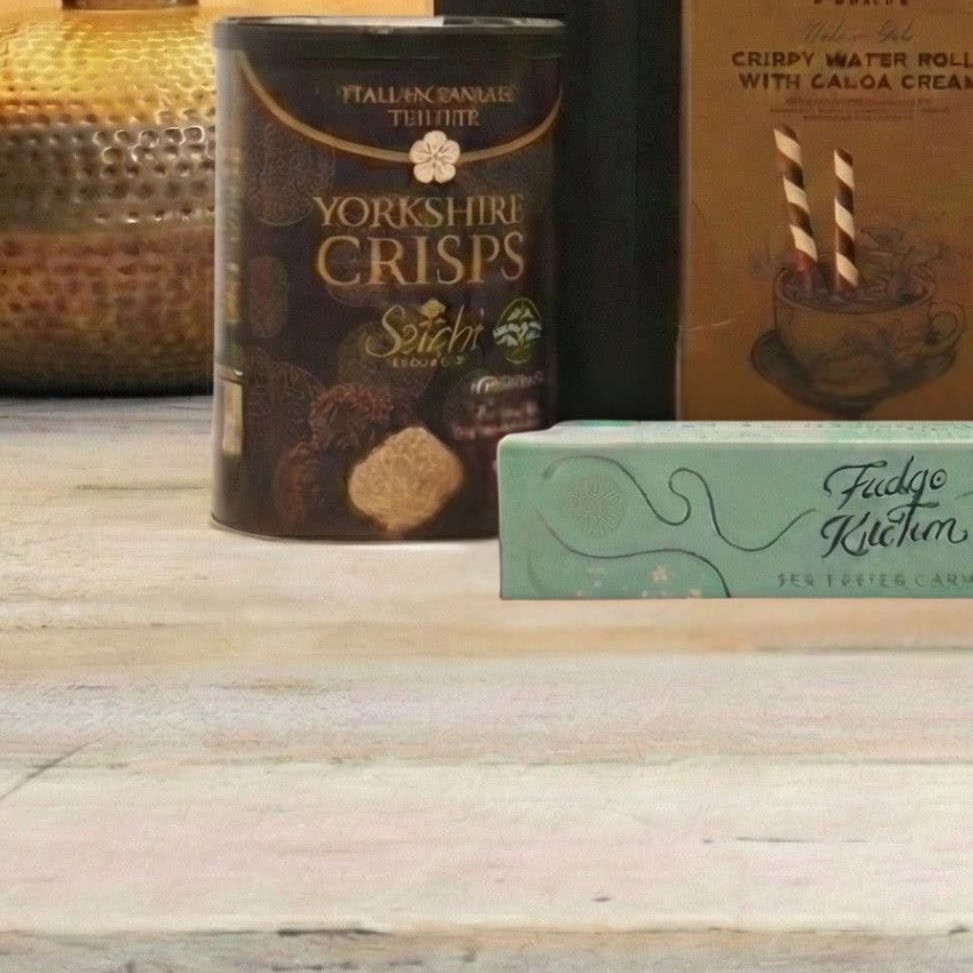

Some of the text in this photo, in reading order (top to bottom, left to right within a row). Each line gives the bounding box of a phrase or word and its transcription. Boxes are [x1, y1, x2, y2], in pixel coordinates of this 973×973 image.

[739, 73, 801, 90] WITH
[313, 195, 526, 227] YORKSHIRE
[316, 231, 525, 286] CRISPS
